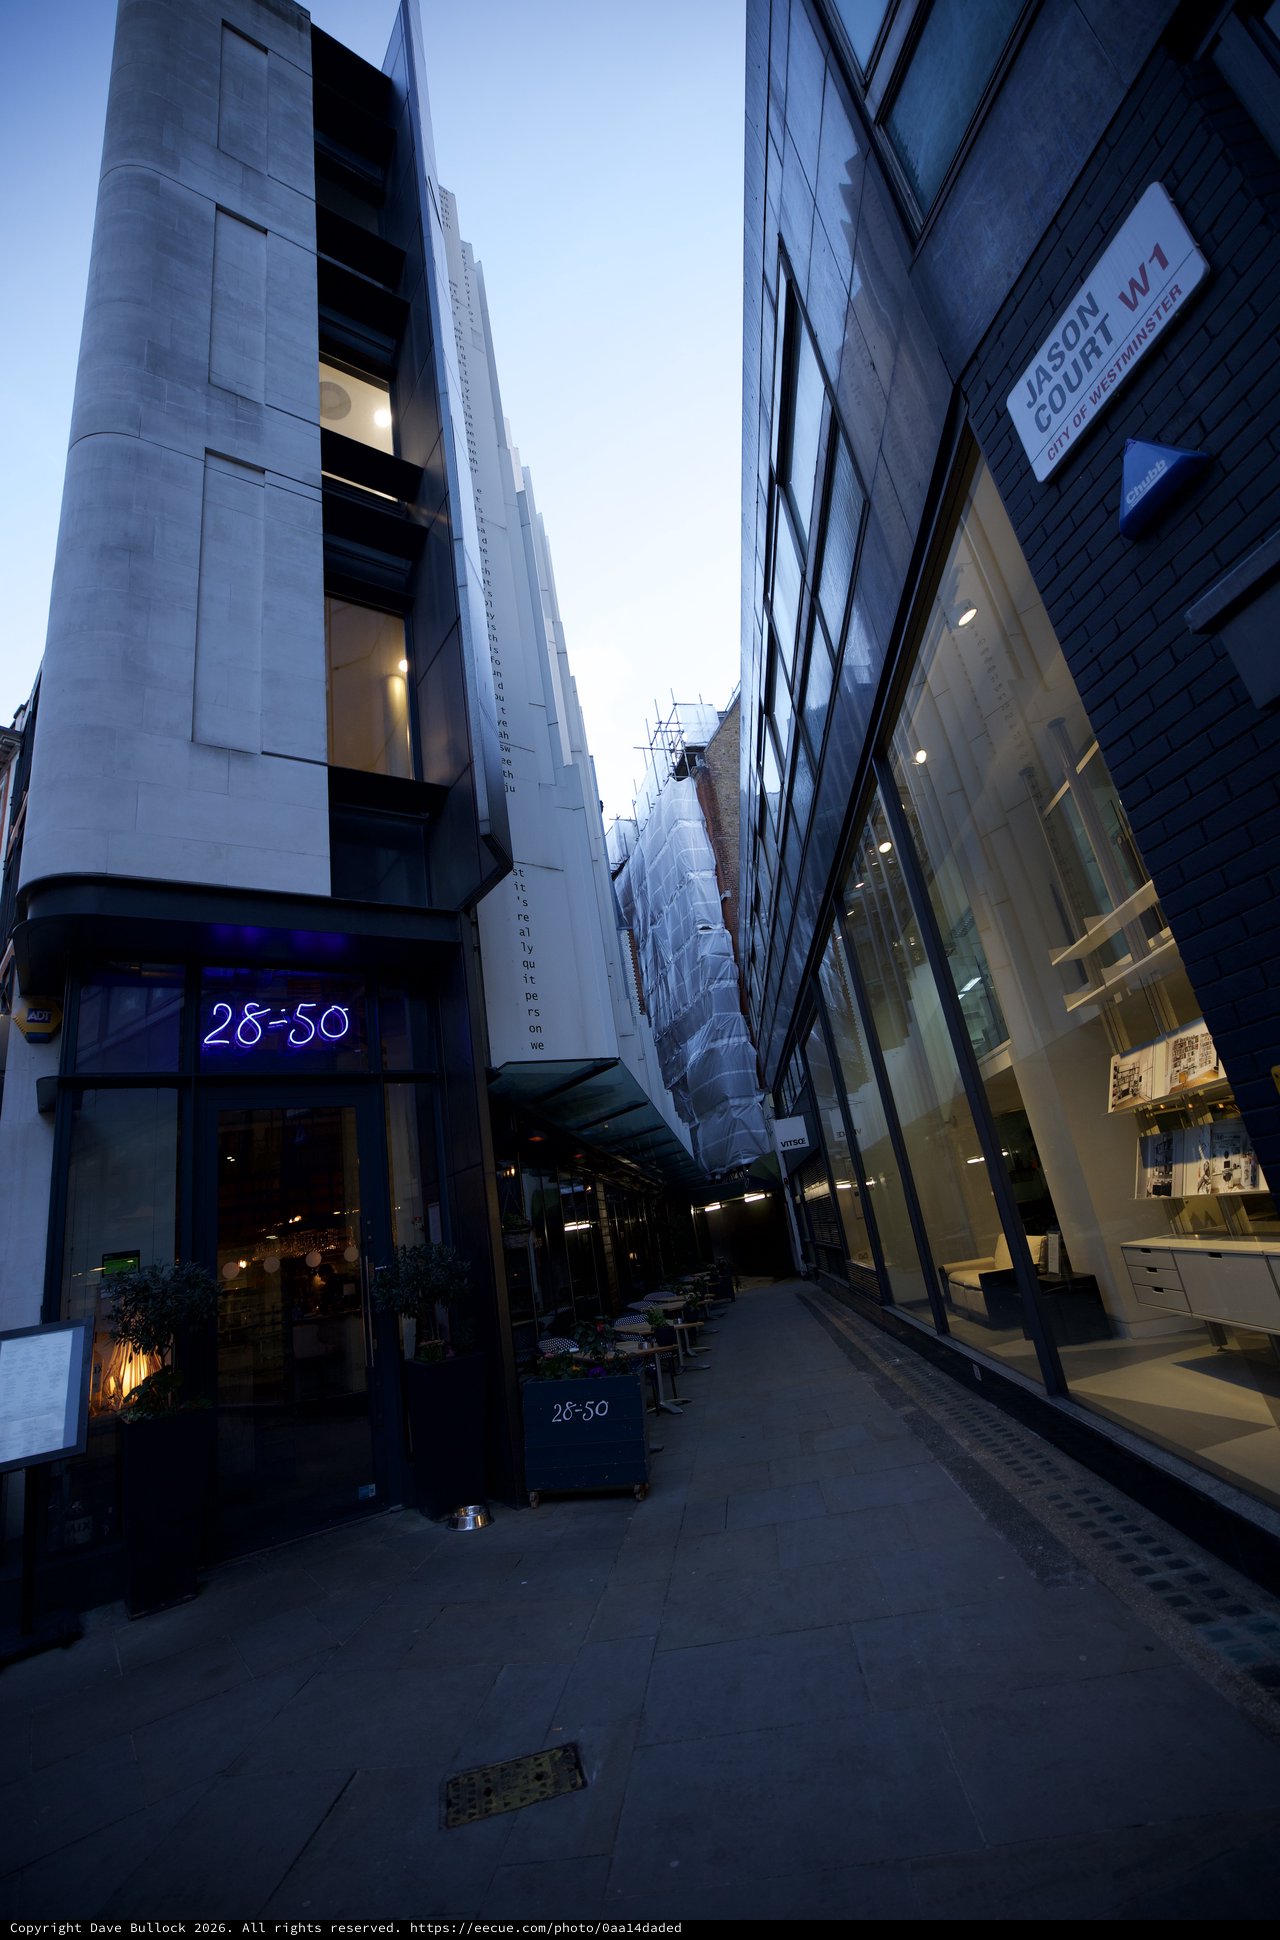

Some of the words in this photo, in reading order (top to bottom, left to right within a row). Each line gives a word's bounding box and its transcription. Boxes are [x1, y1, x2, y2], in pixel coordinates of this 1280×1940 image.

[1025, 291, 1101, 410] JASON
[1117, 241, 1171, 314] W1
[1033, 313, 1115, 434] COURT
[1046, 429, 1072, 463] CITY
[1072, 406, 1090, 430] OF
[1088, 283, 1184, 406] WESTMINSTER
[1125, 458, 1167, 506] Chubb
[27, 1009, 52, 1021] ADT
